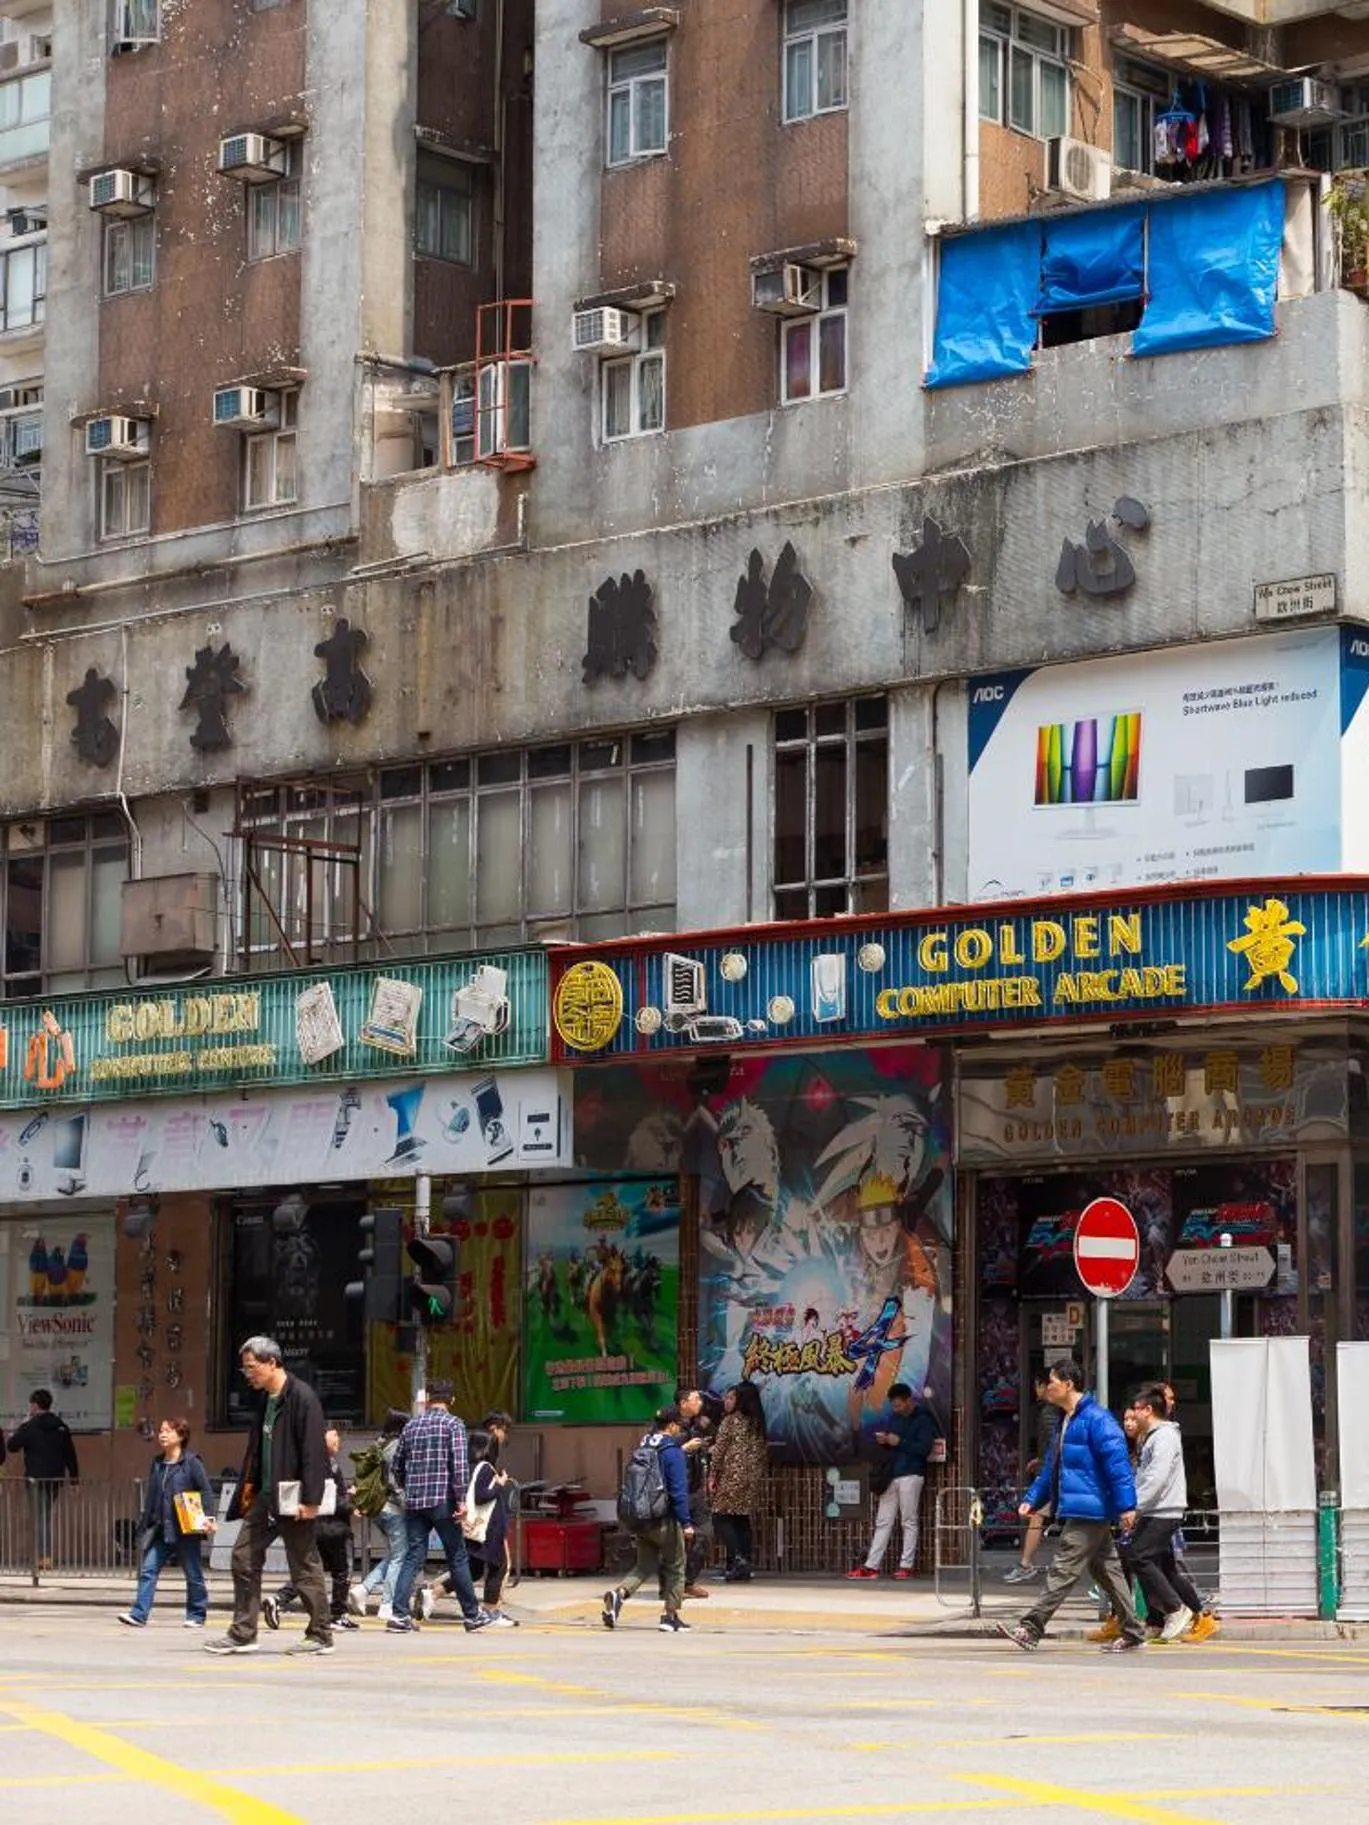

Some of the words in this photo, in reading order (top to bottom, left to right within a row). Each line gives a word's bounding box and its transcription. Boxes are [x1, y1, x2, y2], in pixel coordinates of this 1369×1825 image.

[1304, 577, 1332, 591] Street
[973, 686, 1005, 703] AOC
[1255, 695, 1278, 707] Light
[917, 911, 1143, 973] GOLDEN
[875, 975, 1042, 1021] COMPUTER
[1053, 963, 1187, 1006] ARCADE
[106, 990, 262, 1043] GOLDEN
[0, 1009, 75, 1090] 心
[1005, 1042, 1296, 1110] 黃金電腦商場
[1004, 1118, 1082, 1143] GOLDEN
[1096, 1111, 1200, 1138] COMPUTER
[1211, 1105, 1296, 1129] ARCADE
[1230, 1251, 1259, 1263] Street
[17, 1311, 95, 1335] ViewSonic
[742, 1332, 858, 1383] 終極風暴
[847, 1296, 917, 1391] 4
